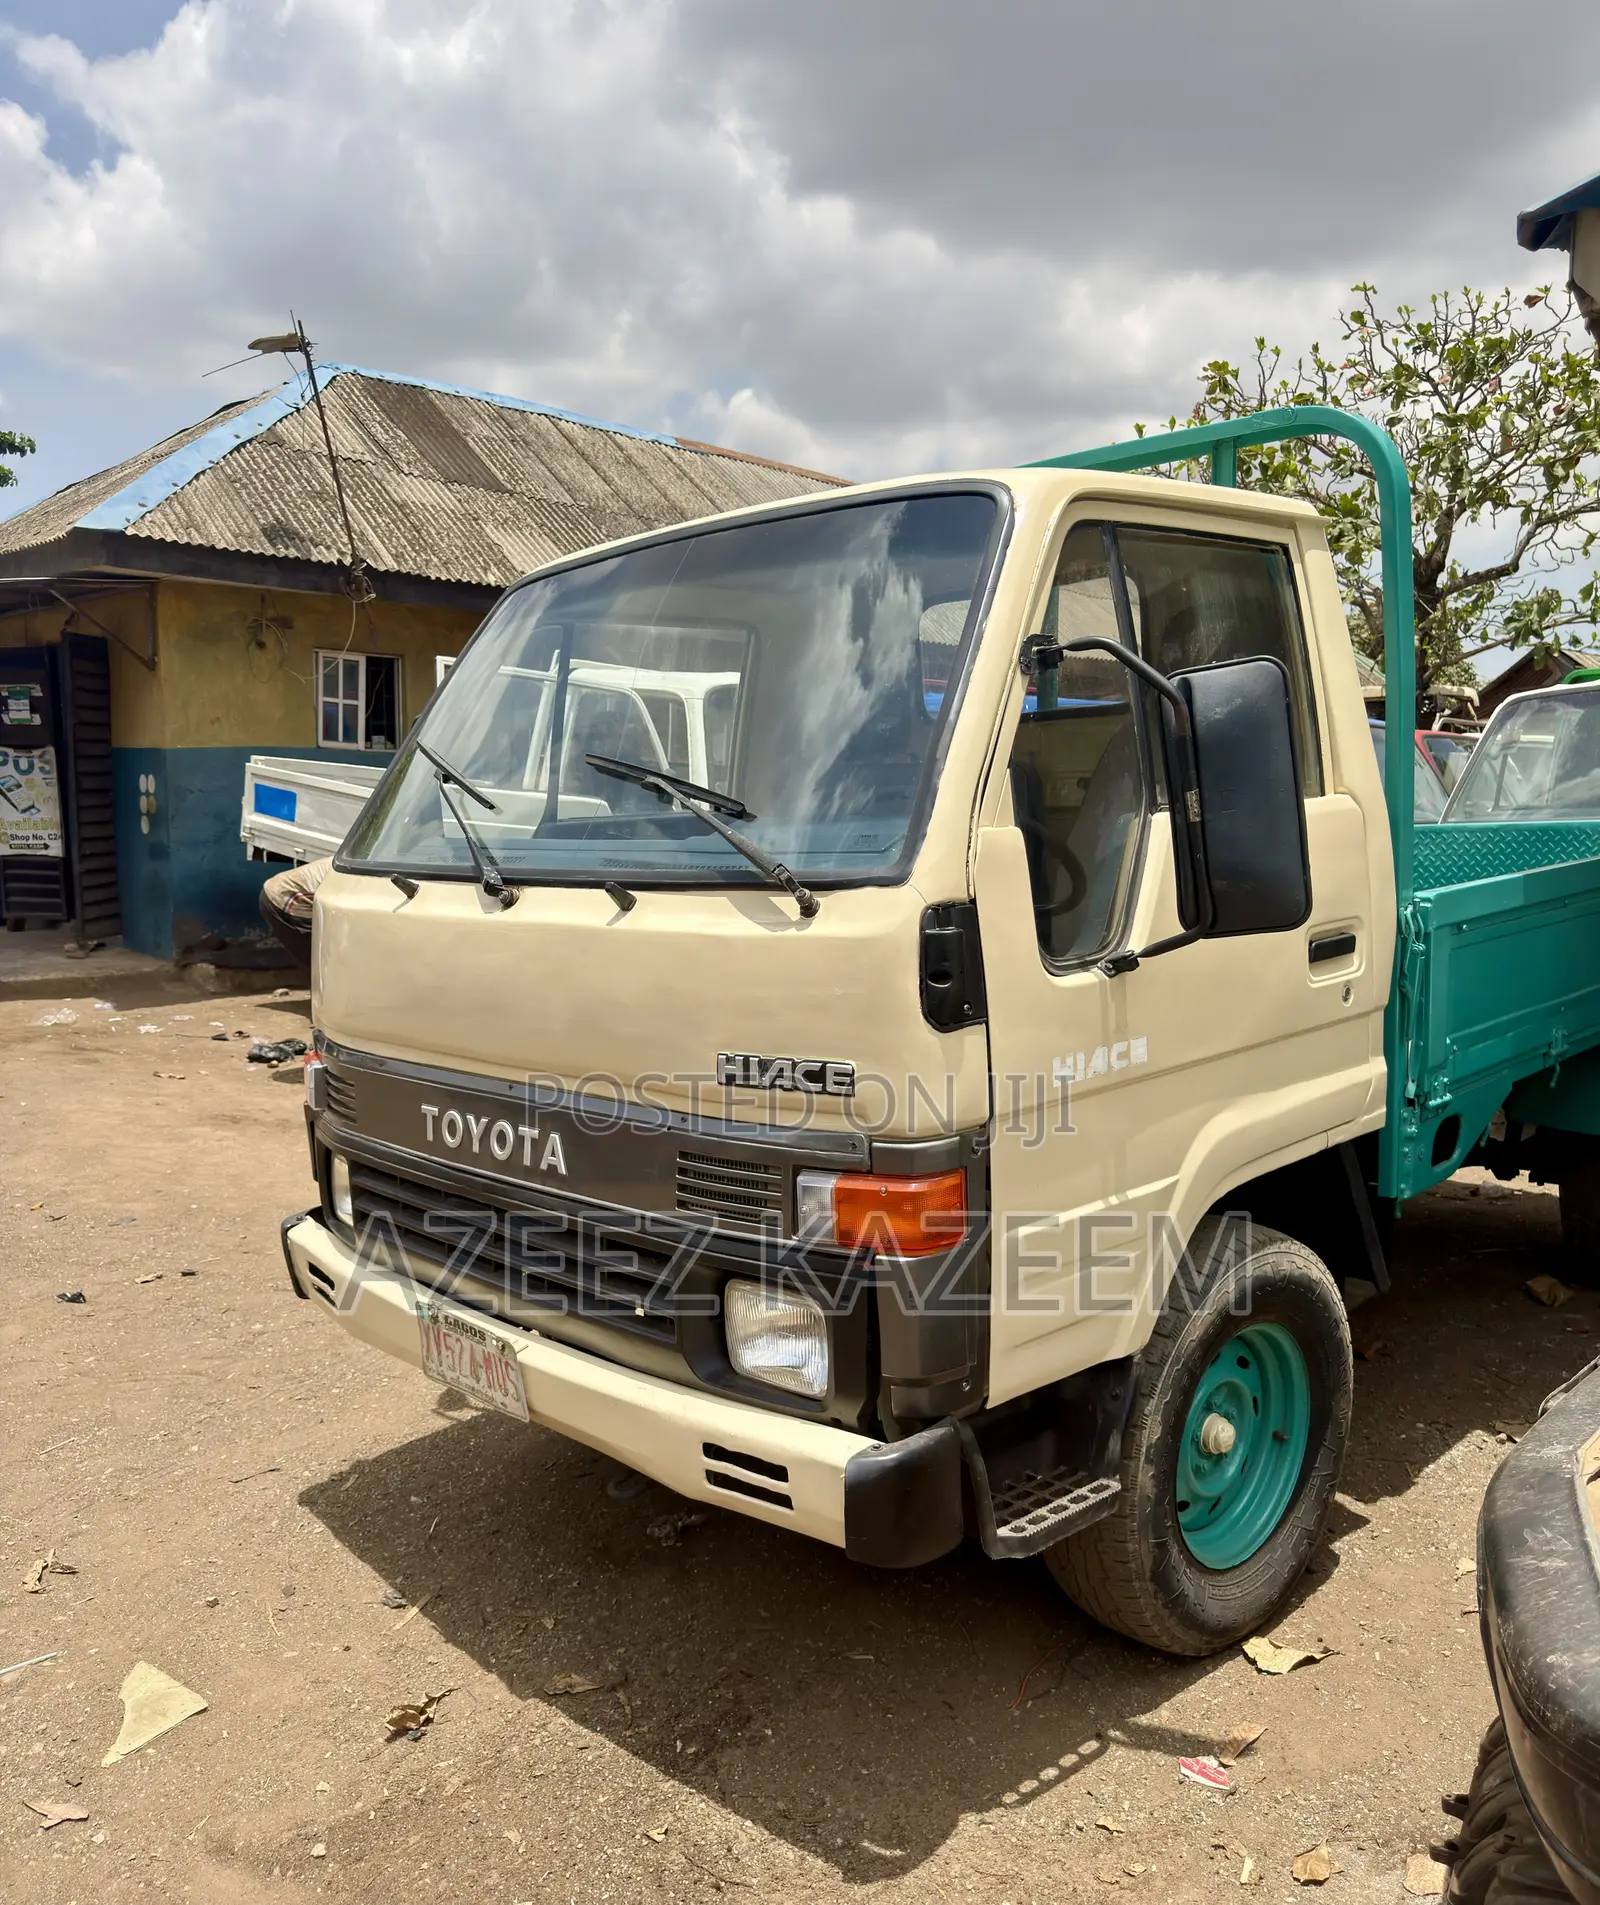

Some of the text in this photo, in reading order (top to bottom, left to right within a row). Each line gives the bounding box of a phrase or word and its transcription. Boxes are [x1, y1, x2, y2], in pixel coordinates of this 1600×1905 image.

[10, 833, 30, 842] Shop
[32, 833, 46, 841] No.
[717, 1052, 857, 1097] HIACE
[420, 1103, 569, 1177] TOYOTA
[444, 1315, 487, 1342] LAGOS
